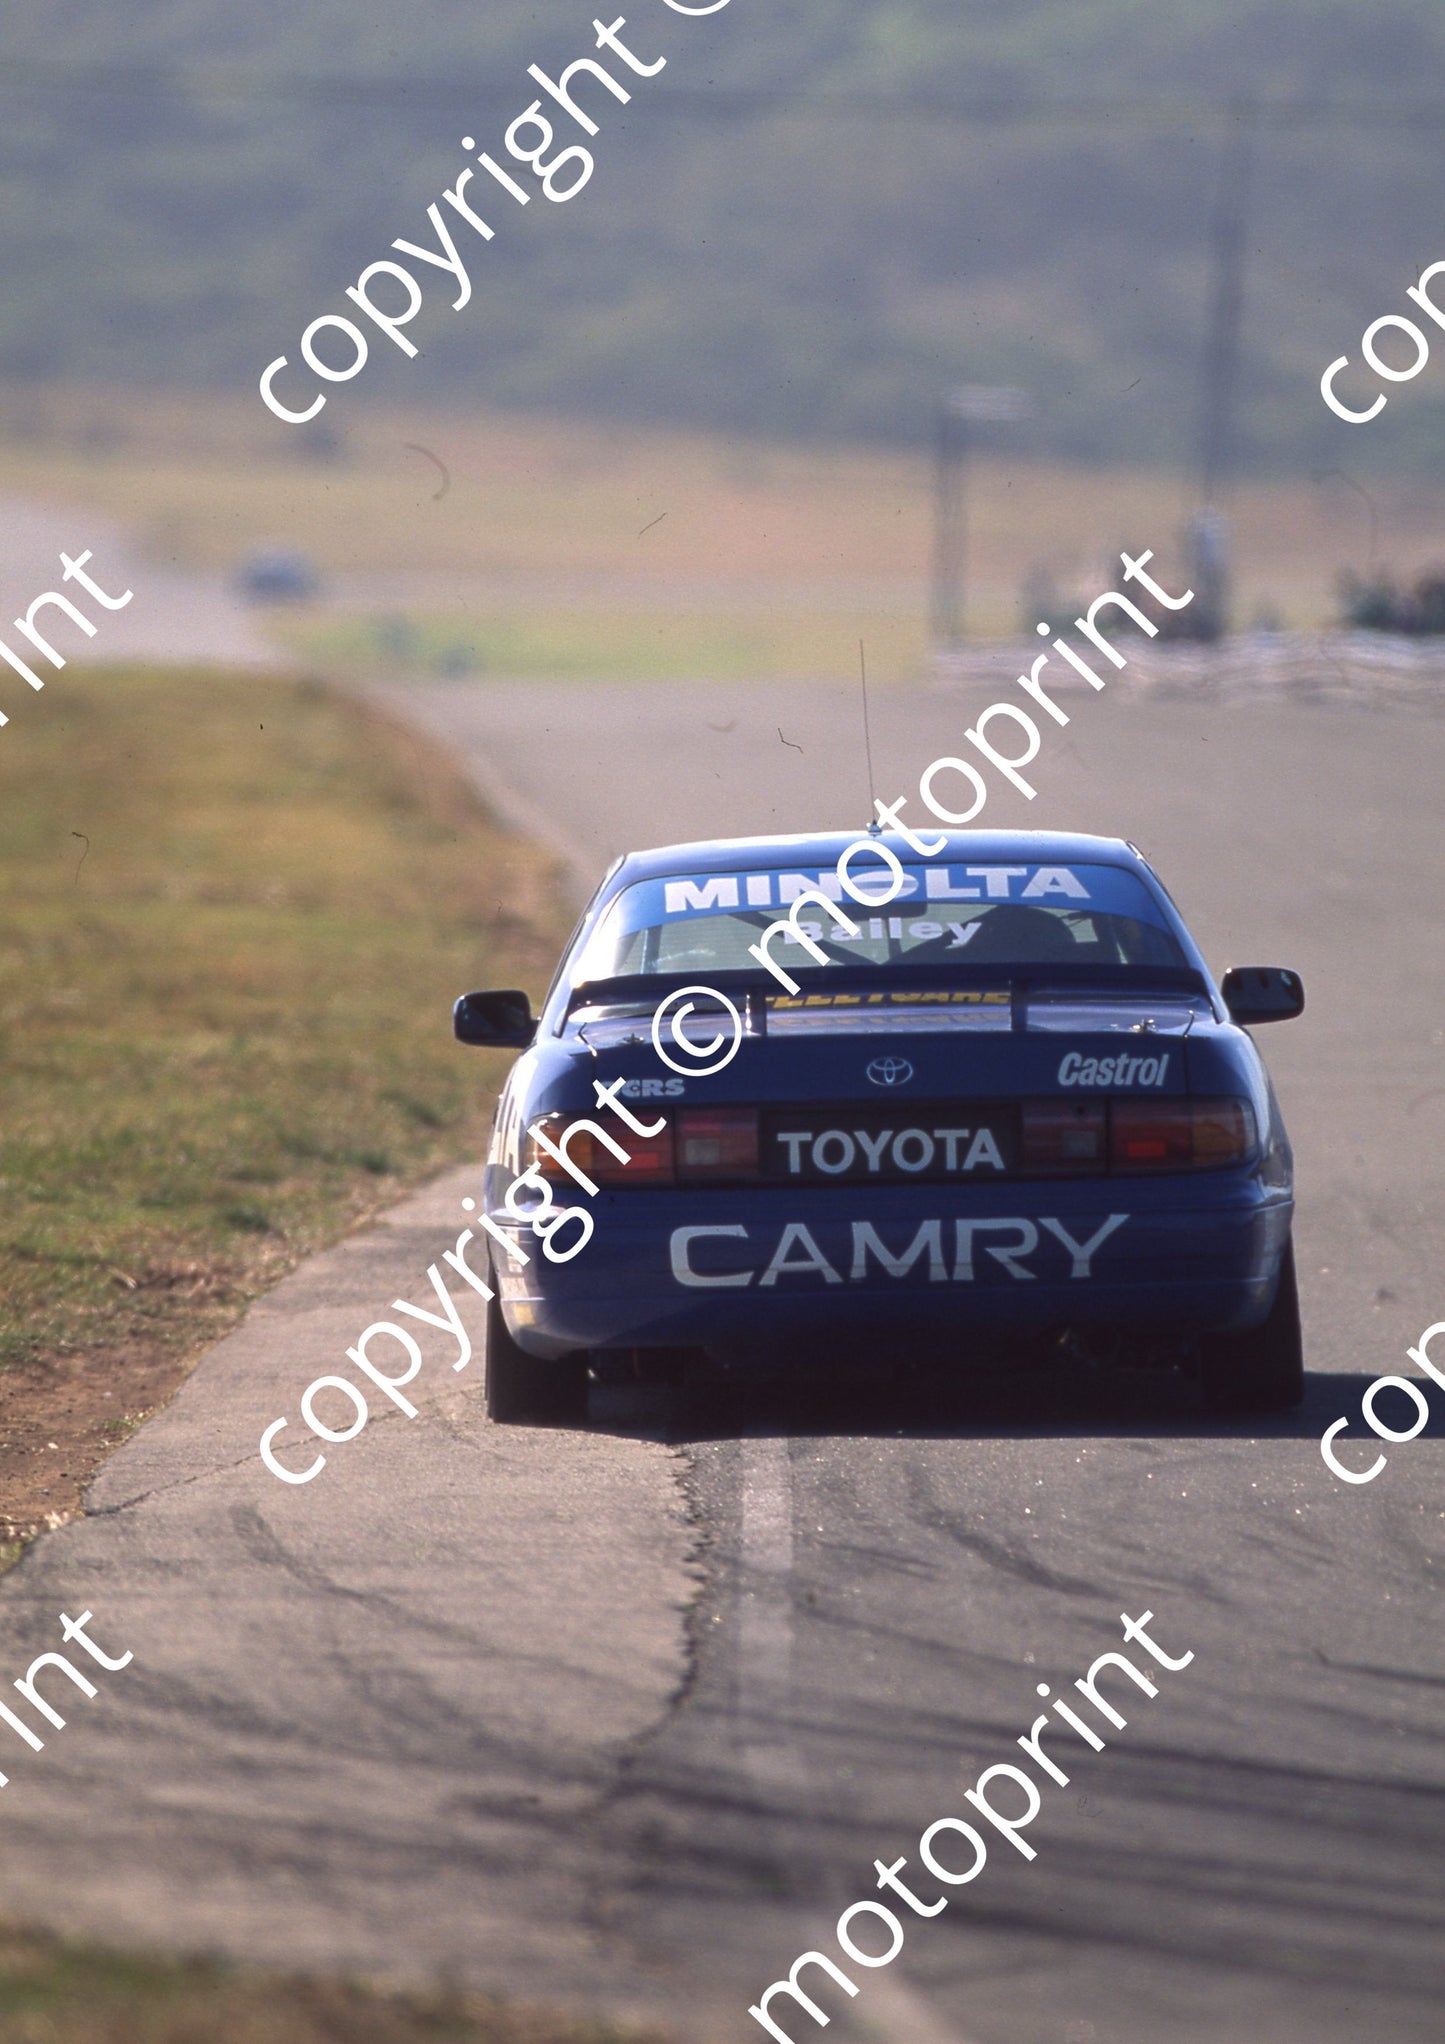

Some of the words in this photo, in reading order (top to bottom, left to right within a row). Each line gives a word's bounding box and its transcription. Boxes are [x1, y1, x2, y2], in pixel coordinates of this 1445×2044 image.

[665, 866, 1092, 914] MINOLTA
[783, 917, 982, 950] Bailey
[1057, 1052, 1170, 1087] Castrol
[777, 1128, 1005, 1174] TOYOTA
[669, 1213, 1131, 1288] CAMRY
